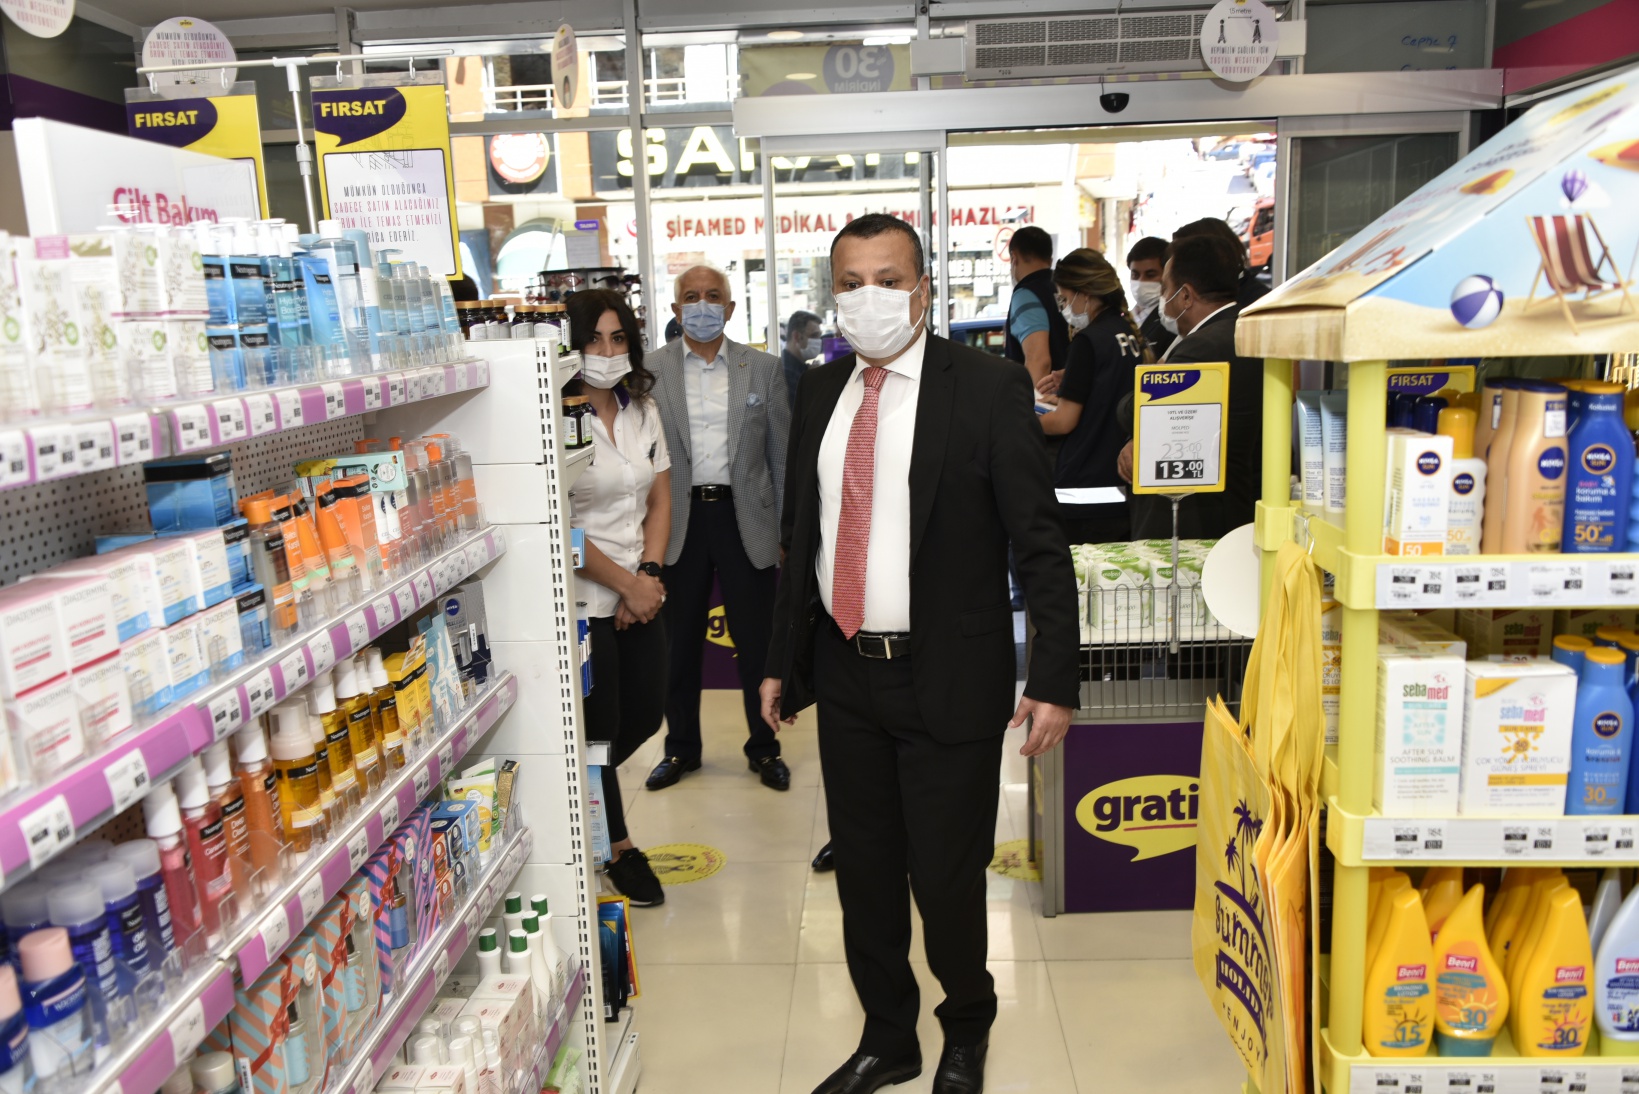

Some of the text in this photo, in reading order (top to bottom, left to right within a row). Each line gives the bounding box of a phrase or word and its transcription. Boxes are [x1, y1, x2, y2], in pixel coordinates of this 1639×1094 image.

[321, 100, 386, 117] FIRSAT
[135, 110, 198, 128] FIRSAT
[343, 182, 427, 197] MÜMKÜN OLDUĞUNCA
[334, 198, 440, 214] SADECE SATIN ALACAĞINIZ
[360, 215, 372, 228] İLE
[377, 214, 401, 227] TEMAS
[405, 213, 442, 226] ETMENİZİ
[666, 214, 746, 242] ŞİFAMED
[754, 209, 837, 235] MDİKAL
[1143, 372, 1186, 384] FIRSAT
[1391, 375, 1434, 386] FIRSAT
[1192, 470, 1203, 478] TL
[1403, 682, 1448, 700] sebamed
[1500, 705, 1545, 722] sebamed
[1584, 785, 1607, 804] 30
[1093, 783, 1198, 832] grati
[1448, 956, 1476, 968] Benri
[1399, 967, 1424, 978] Benri
[1557, 969, 1583, 978] Benri
[1461, 1008, 1488, 1026] 30
[1400, 1025, 1421, 1042] 15
[1555, 1028, 1578, 1044] 30
